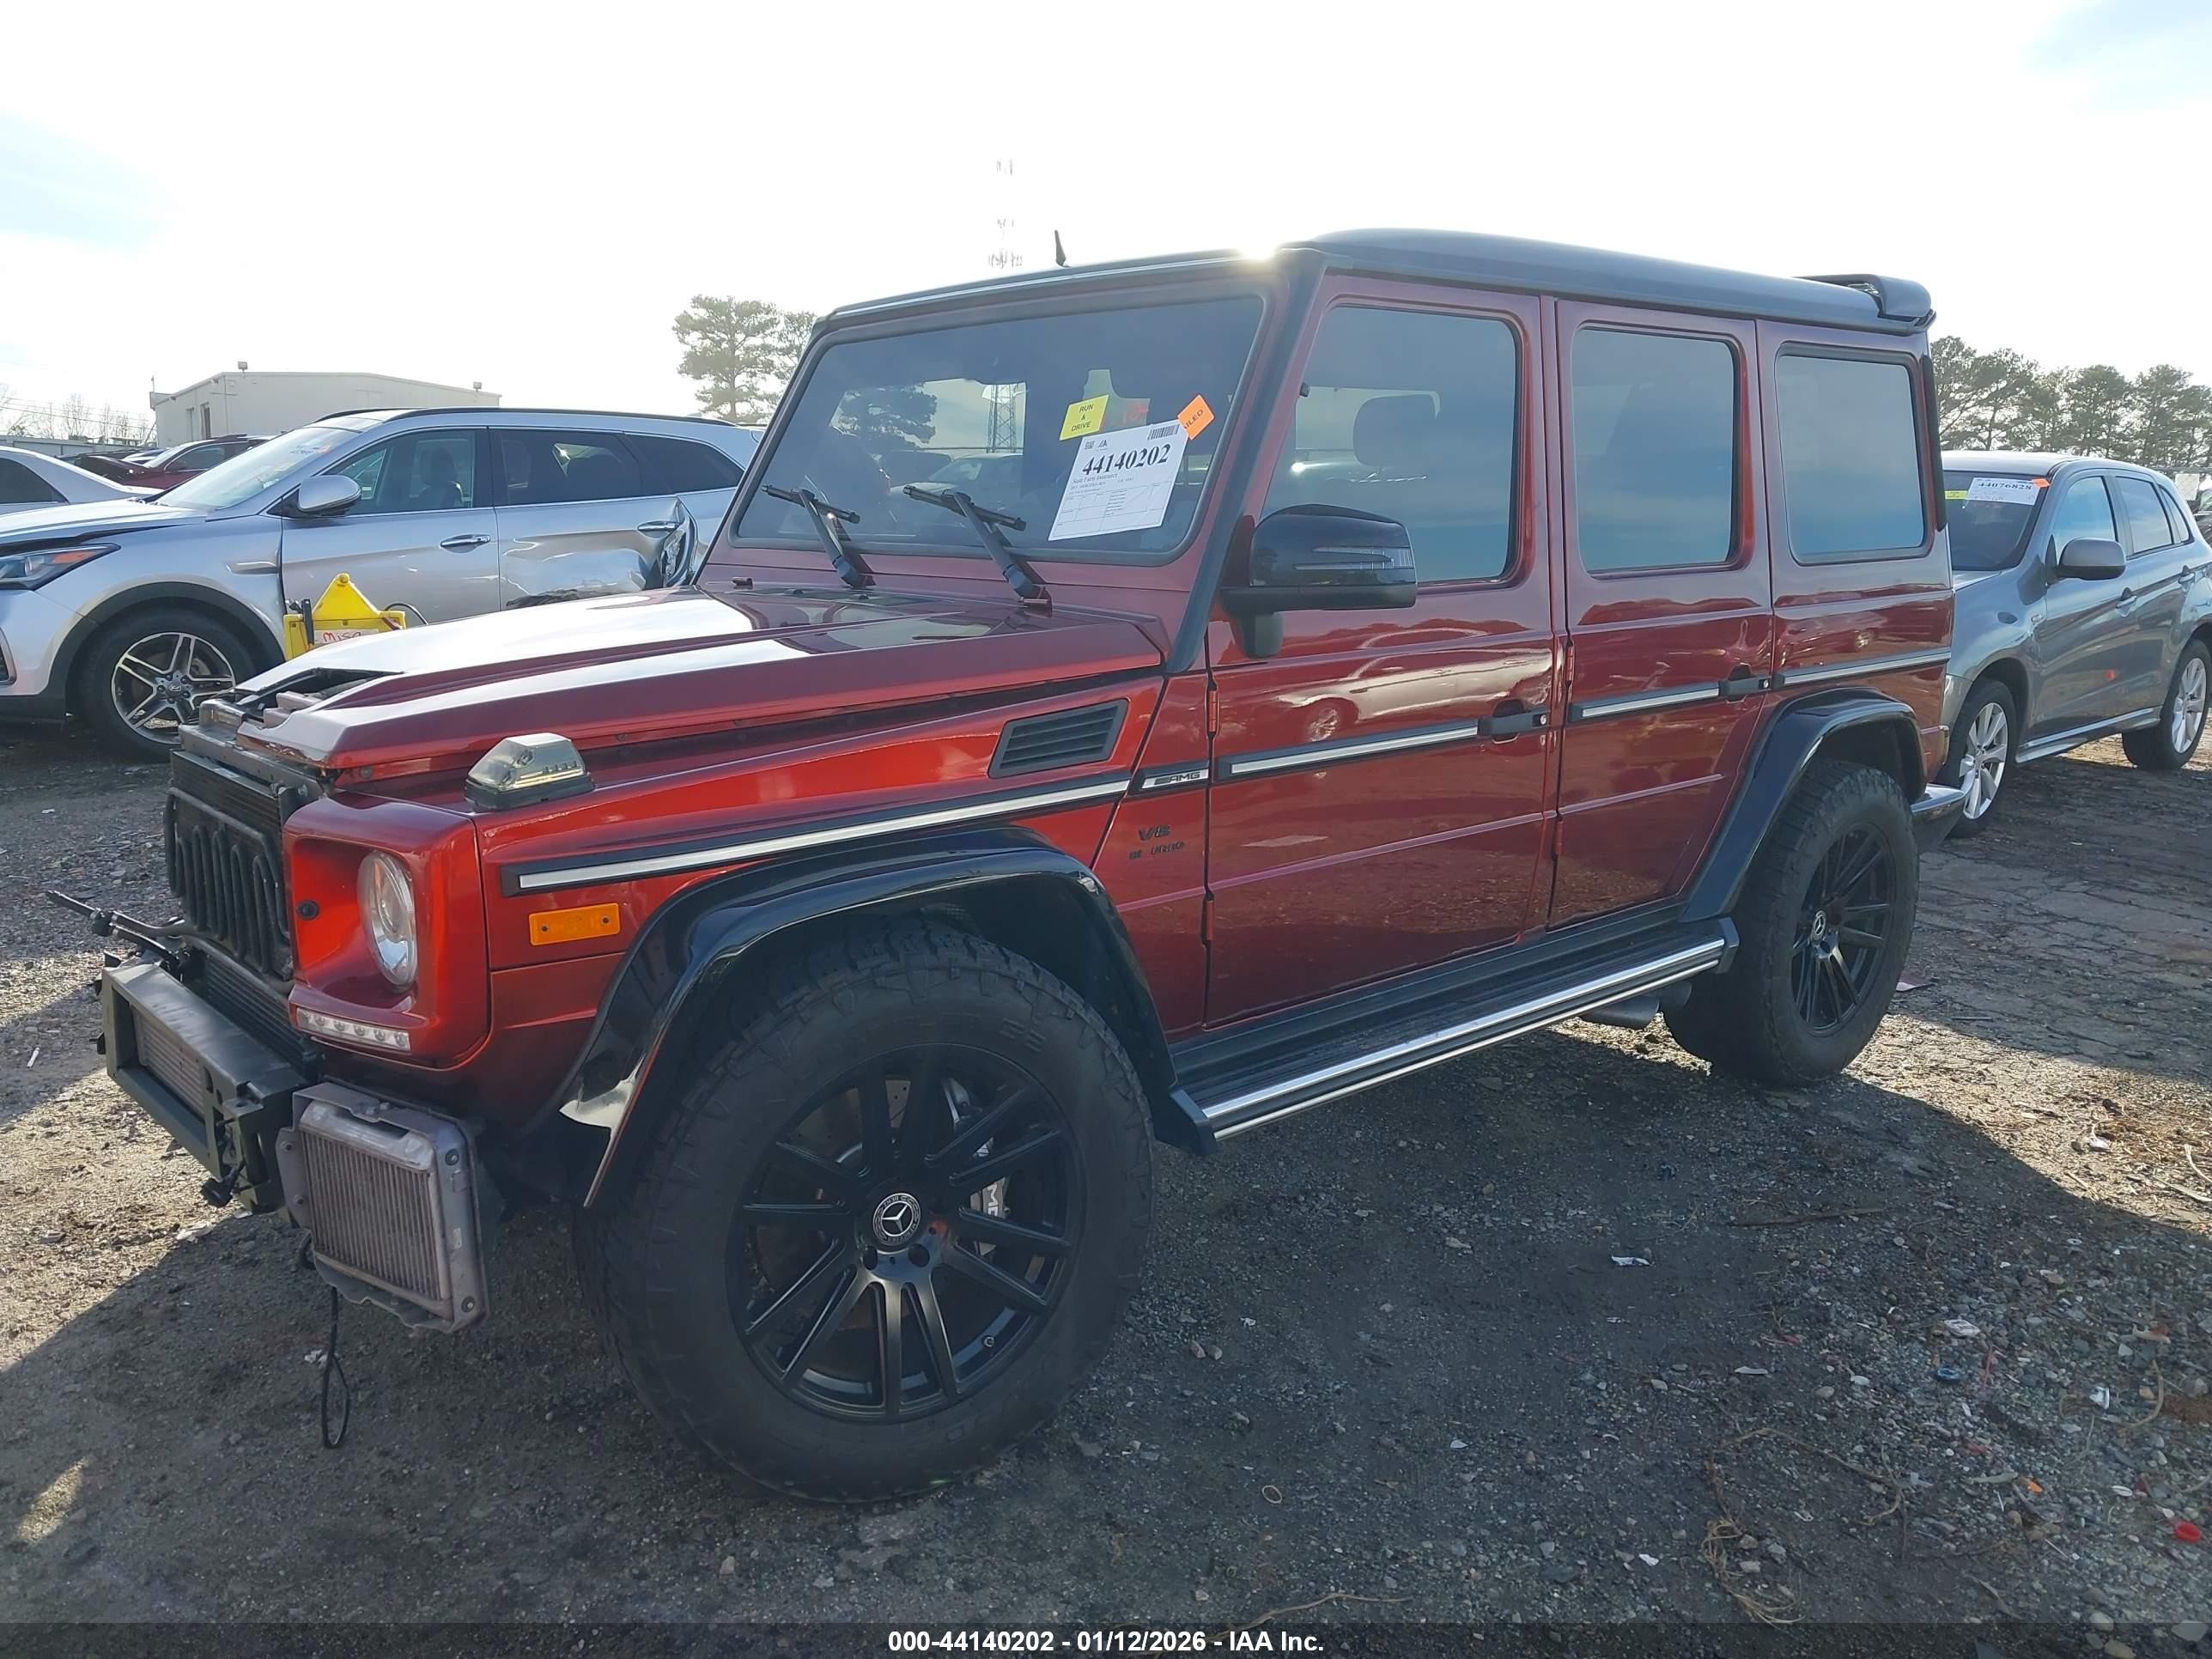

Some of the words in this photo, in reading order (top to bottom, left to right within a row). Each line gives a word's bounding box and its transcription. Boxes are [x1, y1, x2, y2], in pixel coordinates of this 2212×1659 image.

[1079, 403, 1094, 413] RUN
[1071, 420, 1092, 432] DRIVE
[1082, 443, 1171, 476] 44140202
[1170, 771, 1200, 782] AMG
